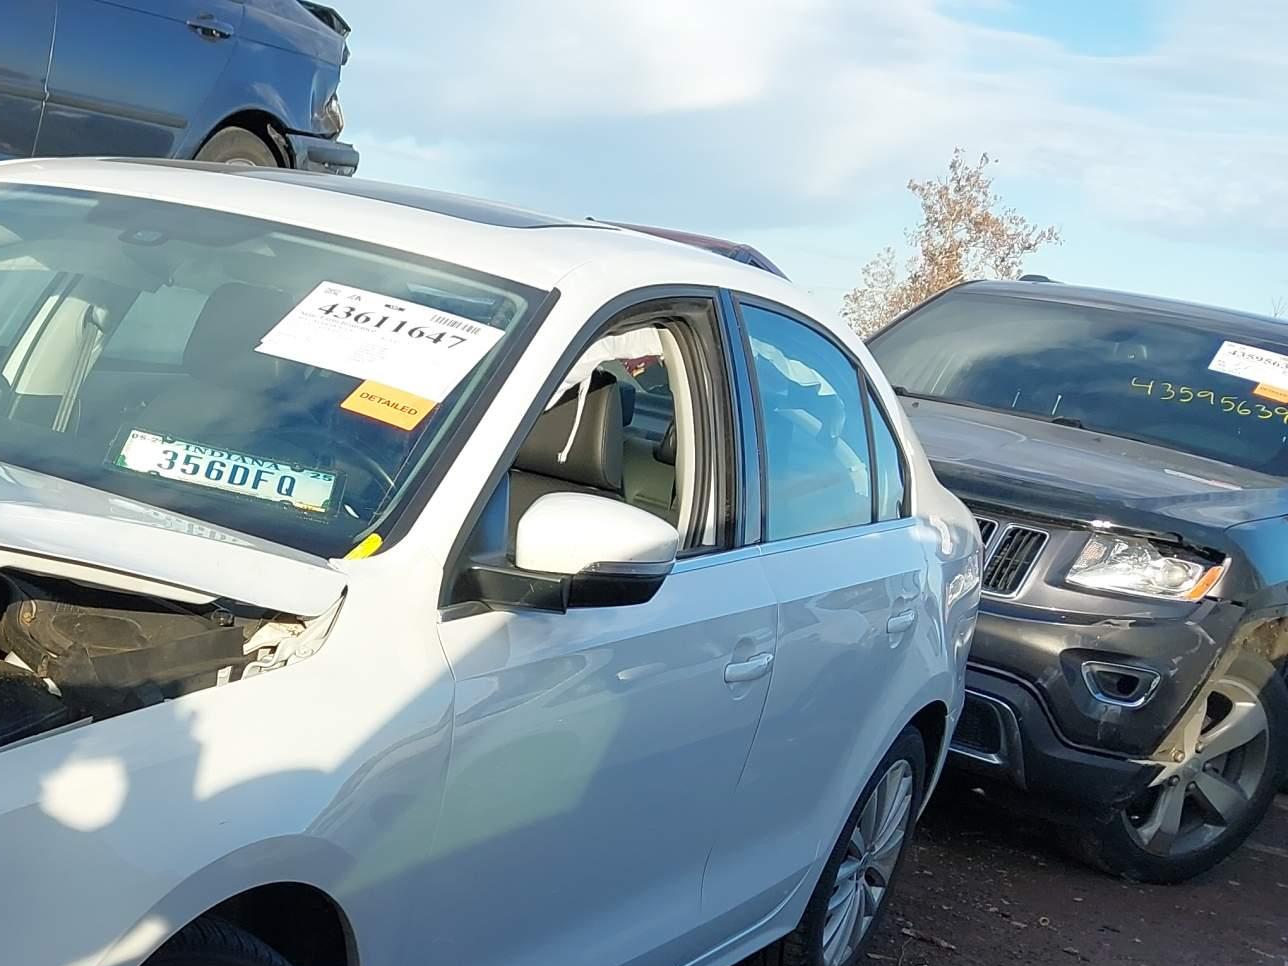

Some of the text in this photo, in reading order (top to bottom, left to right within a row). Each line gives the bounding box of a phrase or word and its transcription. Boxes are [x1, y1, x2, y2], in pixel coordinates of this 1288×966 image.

[318, 303, 467, 349] 43611647
[359, 391, 418, 416] DETAILED
[1131, 377, 1288, 424] 43595639
[157, 449, 297, 497] 356DFQ
[184, 444, 282, 471] INDIANA
[309, 472, 333, 482] 25
